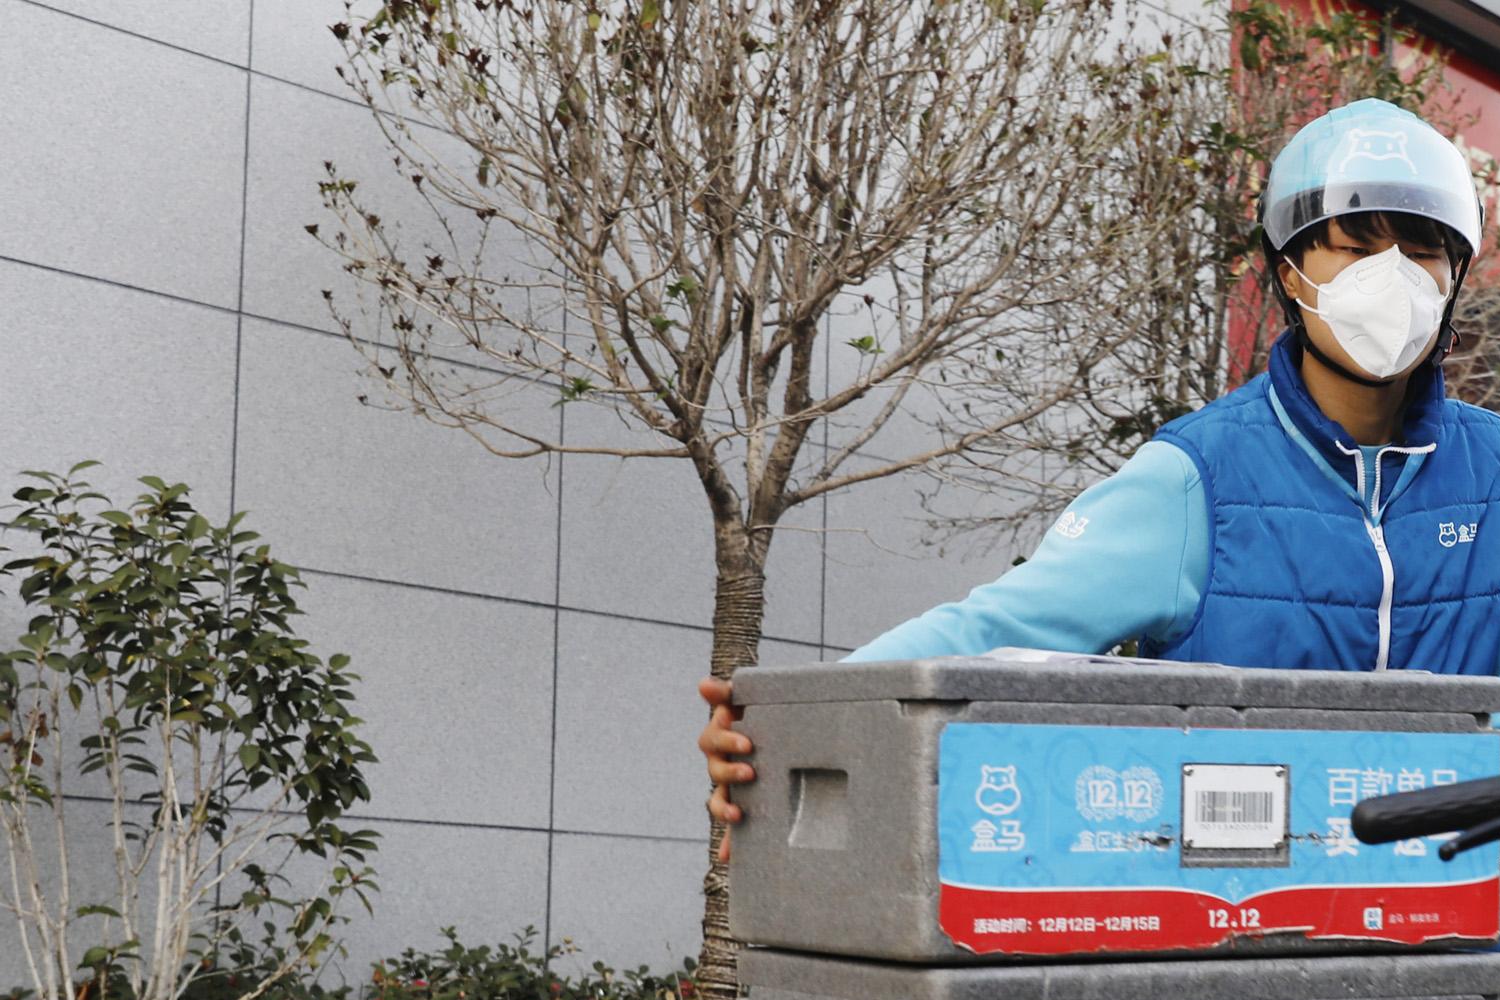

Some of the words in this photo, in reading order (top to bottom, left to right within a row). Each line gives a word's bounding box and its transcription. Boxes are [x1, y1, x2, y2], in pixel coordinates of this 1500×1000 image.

[1457, 523, 1478, 543] 盒马
[970, 818, 1026, 853] 盒马
[1207, 908, 1261, 929] 12.12
